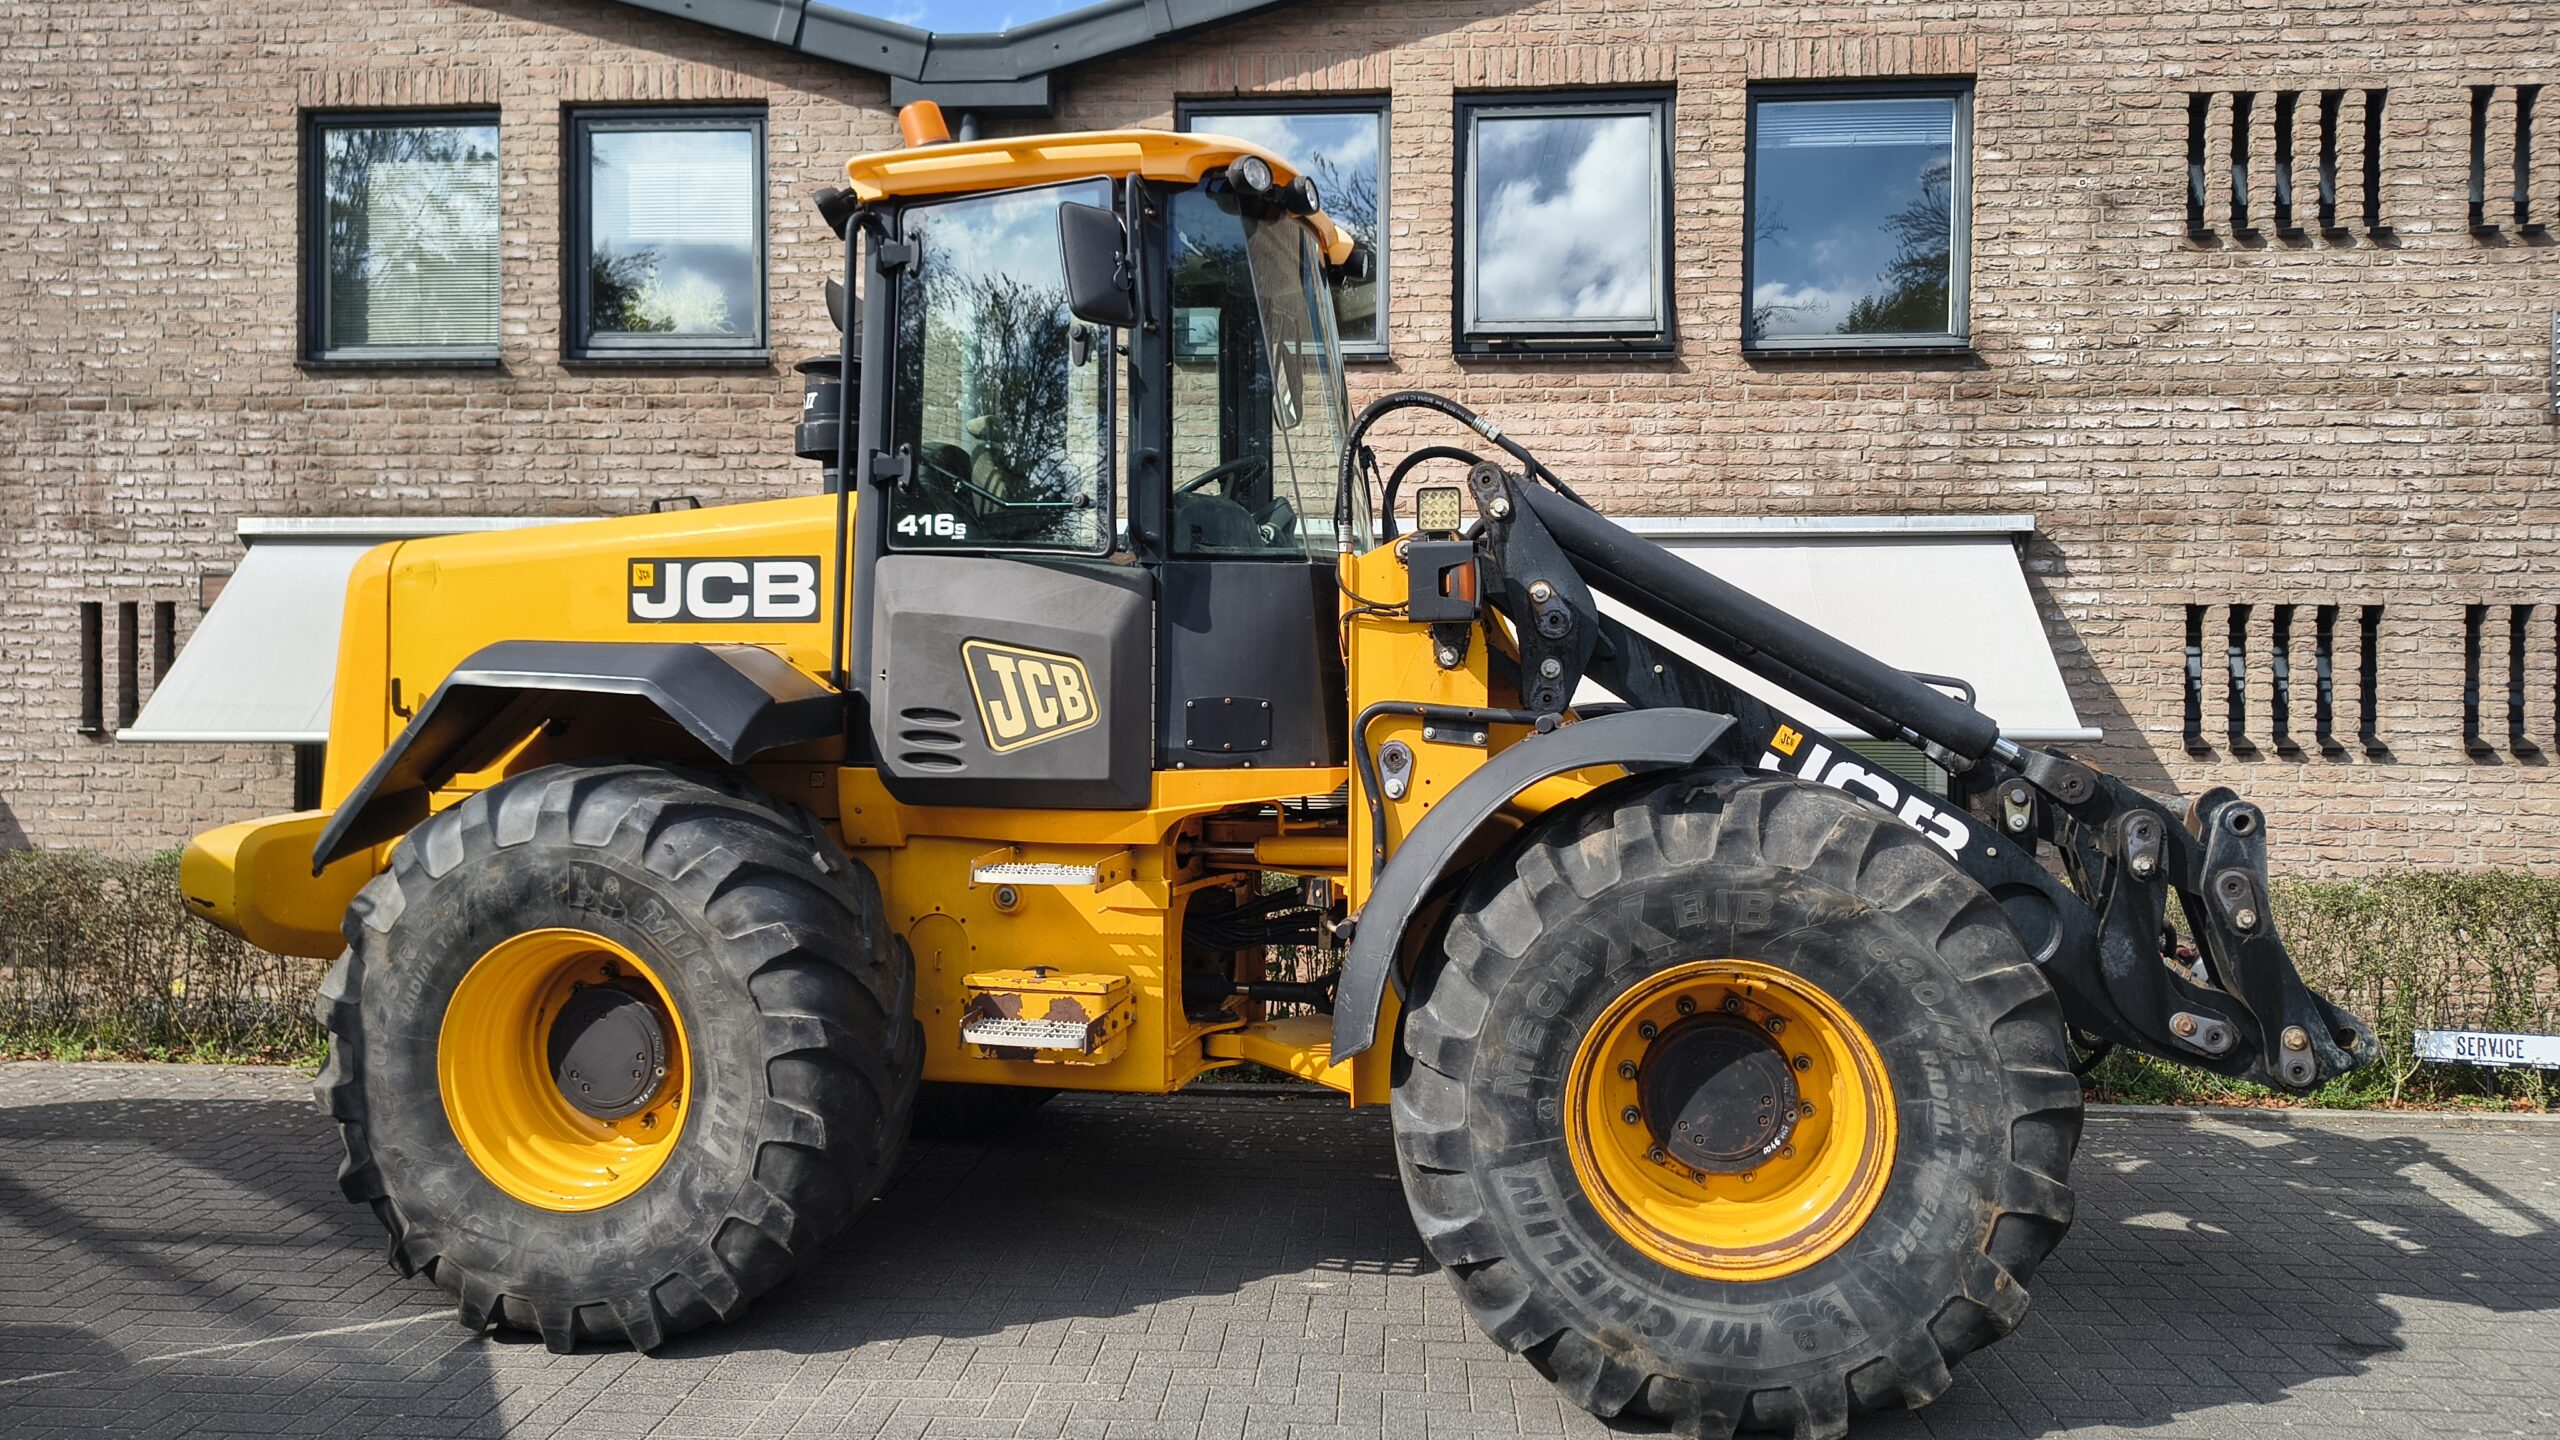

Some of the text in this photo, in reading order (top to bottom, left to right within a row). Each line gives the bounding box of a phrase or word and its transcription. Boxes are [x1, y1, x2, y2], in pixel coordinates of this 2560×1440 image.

[632, 562, 817, 618] JCB
[987, 653, 1088, 739] JCB
[2456, 1036, 2525, 1059] SERVICE
[1501, 1175, 1764, 1358] MICHELIN
